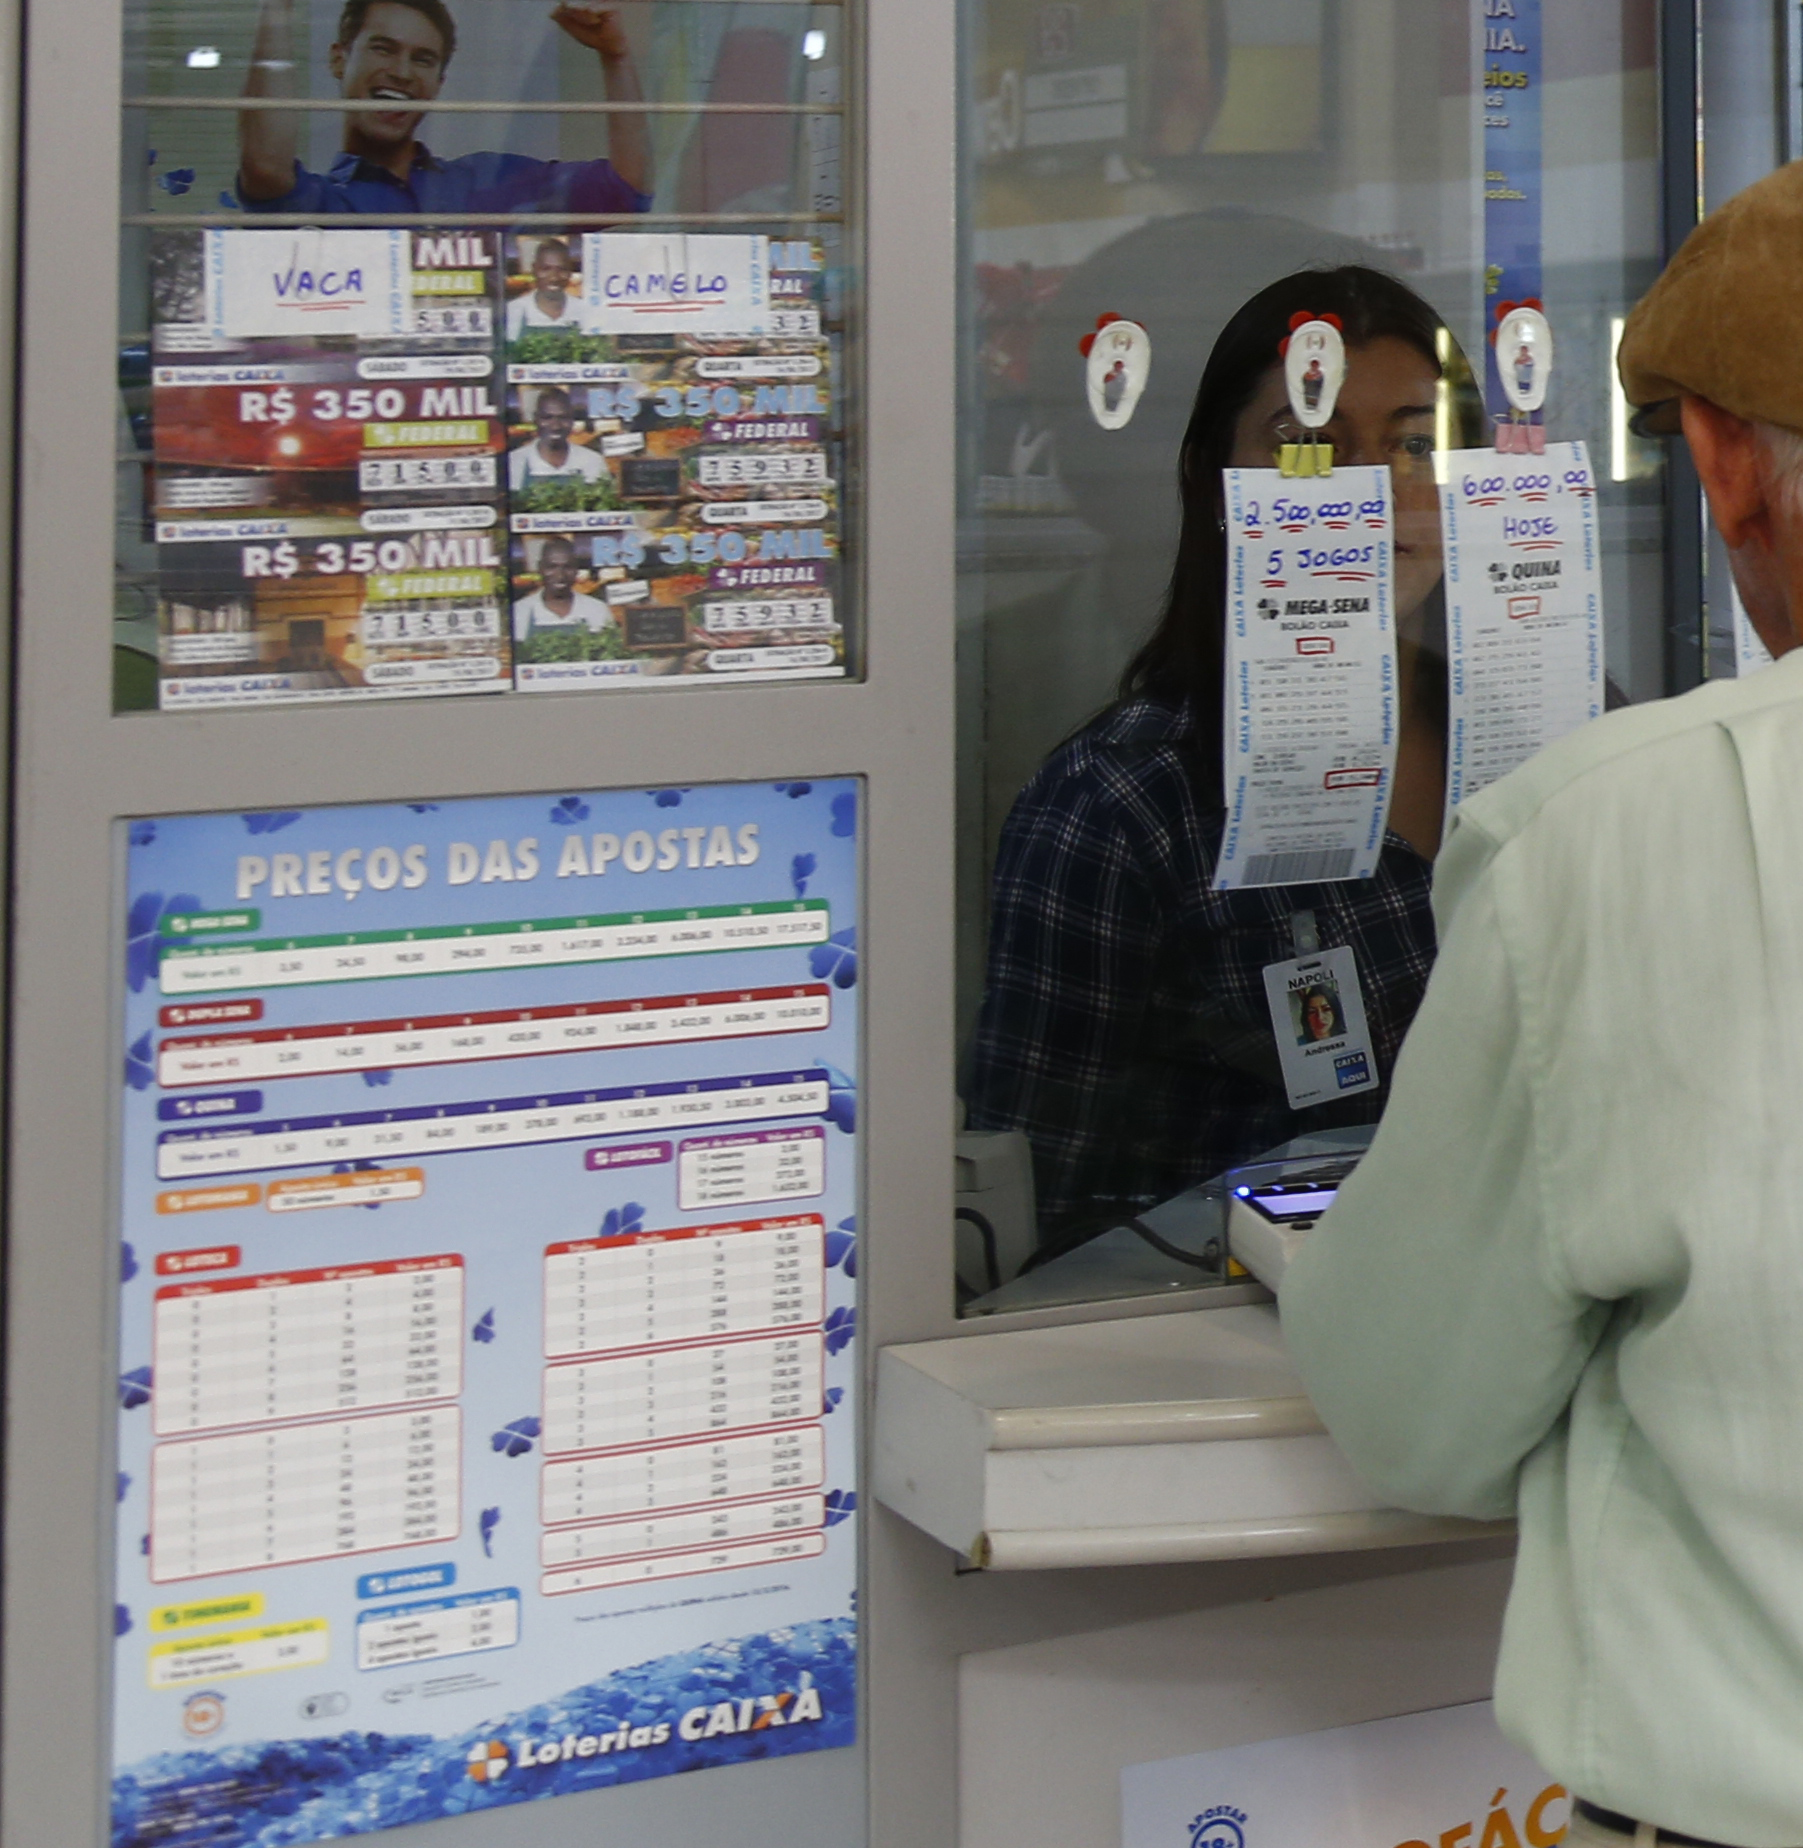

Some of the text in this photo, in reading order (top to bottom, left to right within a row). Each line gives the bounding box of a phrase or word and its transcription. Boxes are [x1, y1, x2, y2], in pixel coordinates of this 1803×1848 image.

[416, 237, 493, 267] MIL
[273, 268, 363, 298] VACA
[605, 274, 728, 298] CAMELO
[235, 369, 284, 381] CAIXA
[583, 368, 630, 379] CAIXA
[239, 387, 498, 424] R$ 350 MIL
[400, 425, 479, 442] FEDERAL
[734, 422, 809, 439] FEDERAL
[1504, 516, 1559, 538] HOJE
[1265, 546, 1375, 576] 5 JOGOS
[1512, 559, 1563, 580] QUINA
[1286, 597, 1371, 616] MEGA-SENA
[235, 821, 762, 902] PREÇOS DAS APOSTAS
[1288, 969, 1335, 990] NAPOLI
[1305, 1040, 1346, 1057] Andressa
[1336, 1055, 1365, 1068] CAIXA
[1341, 1072, 1366, 1085] AQUI
[516, 1720, 671, 1771] Loterias
[678, 1687, 824, 1744] CAIXA
[1187, 1805, 1248, 1834] APOSTAR
